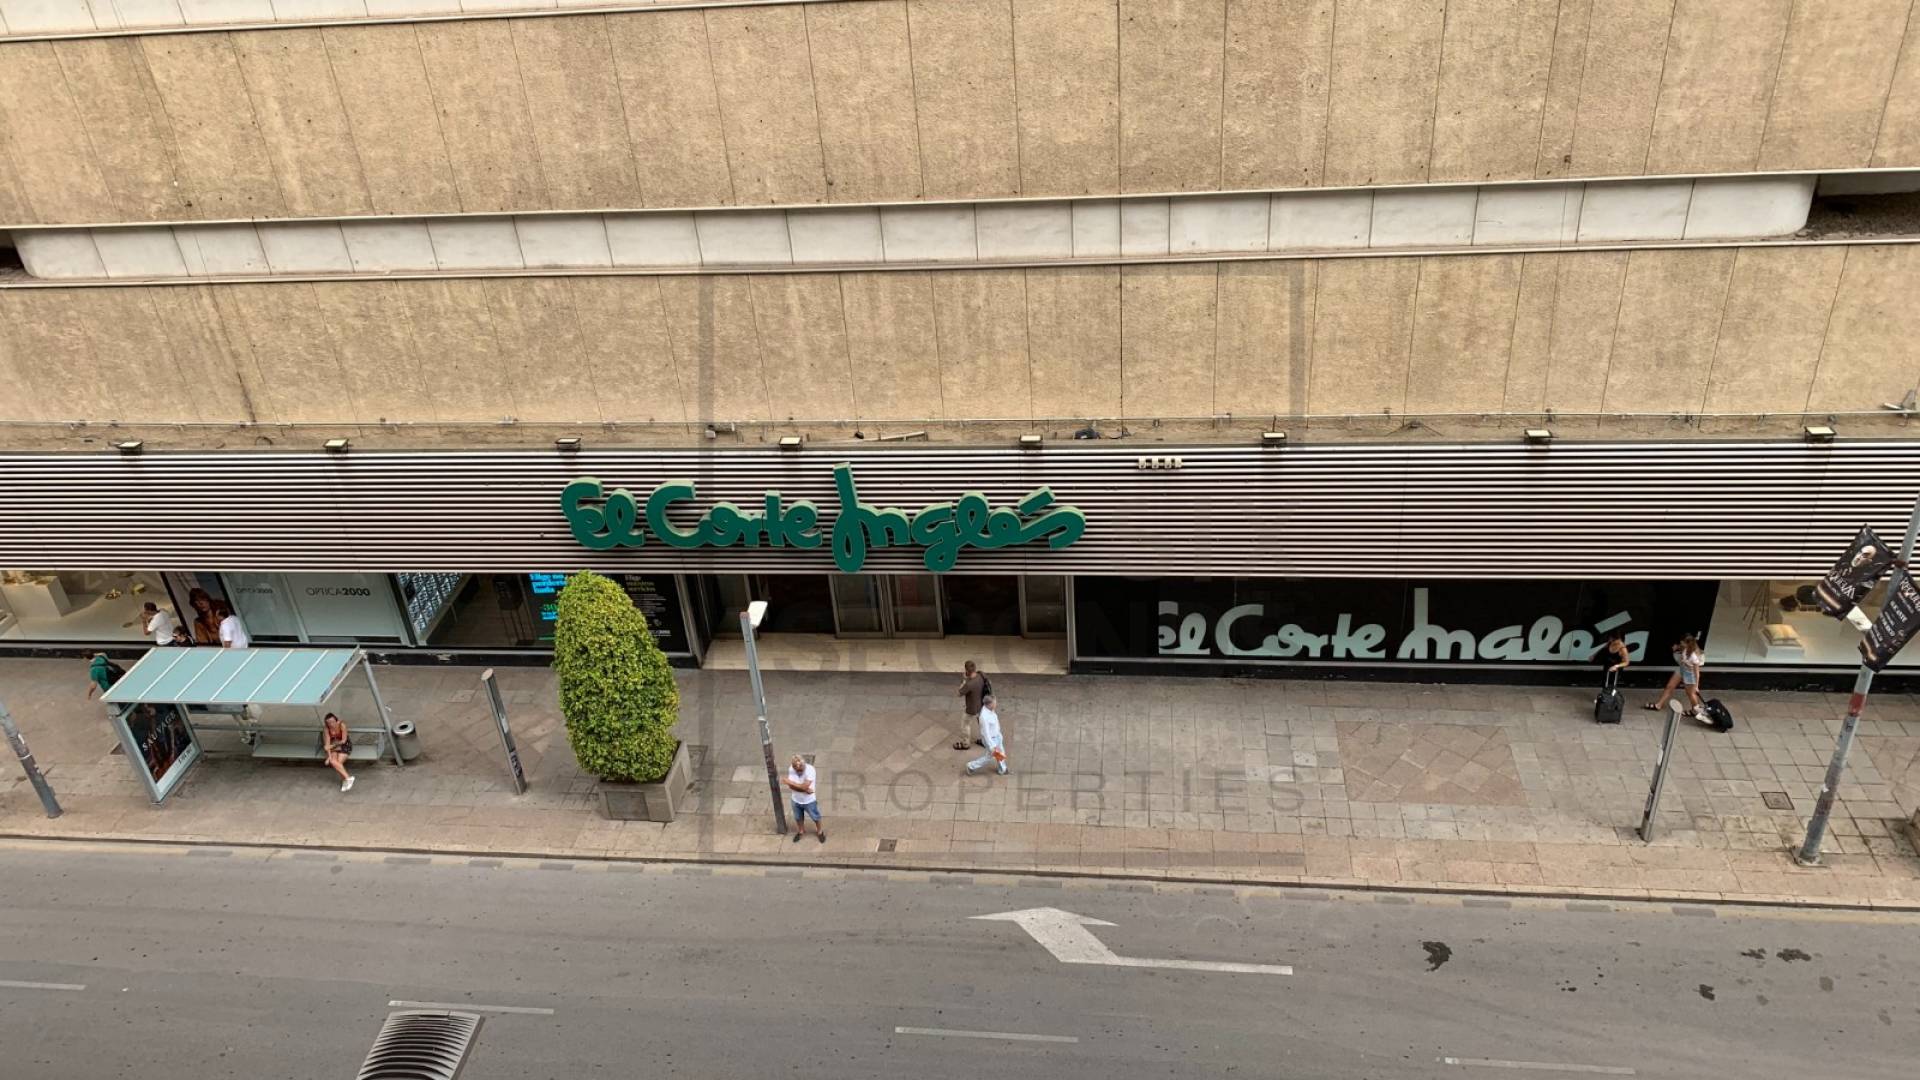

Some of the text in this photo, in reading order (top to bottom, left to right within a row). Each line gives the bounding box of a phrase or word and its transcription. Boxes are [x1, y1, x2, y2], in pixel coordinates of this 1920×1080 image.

[560, 461, 1087, 572] El Corte Inglés
[1215, 604, 1387, 658] Corte
[142, 711, 176, 751] SAUVAGE
